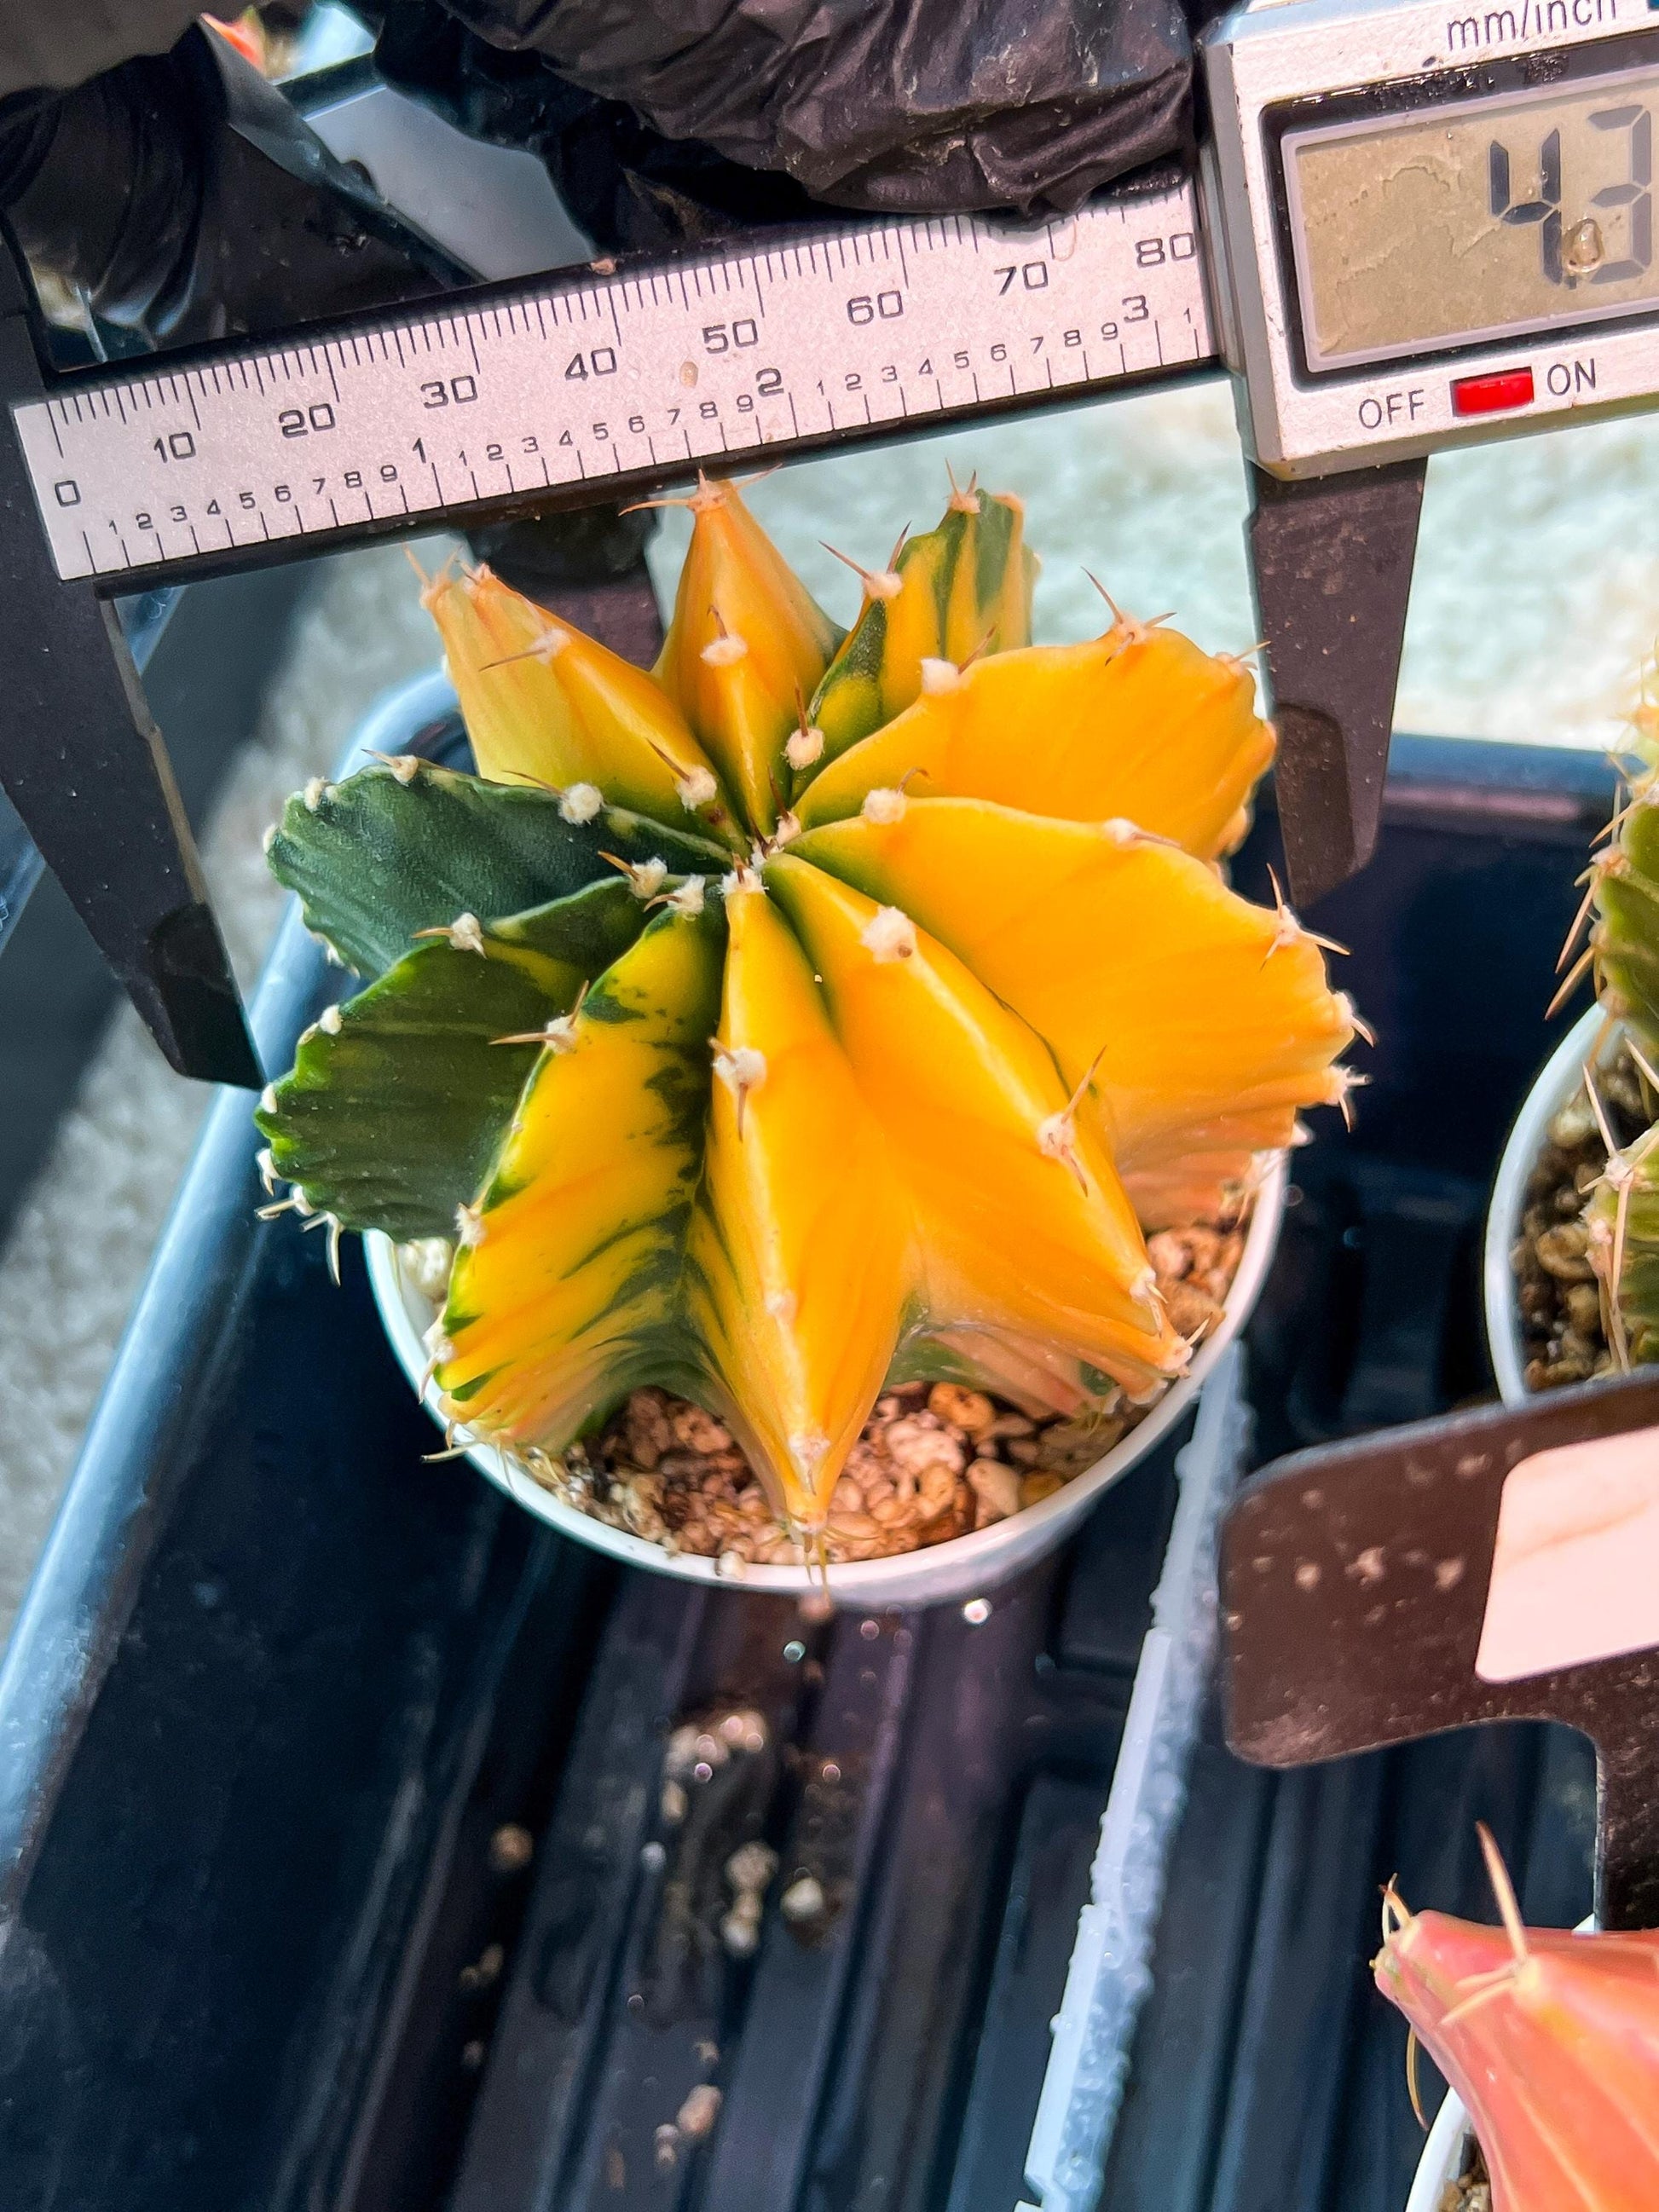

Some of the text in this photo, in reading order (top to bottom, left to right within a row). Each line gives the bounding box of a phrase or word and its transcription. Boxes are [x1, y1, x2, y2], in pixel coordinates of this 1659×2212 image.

[55, 232, 1195, 507] 0 10 20 30 40 50 60 70 80
[108, 294, 1192, 534] 1 2 3 4 5 6 7 8 9 1 1 2 3 4 5 6 7 8 9 2 1 2 3 4 5 6 7 8 9 3 1
[1358, 358, 1597, 430] OFF ON
